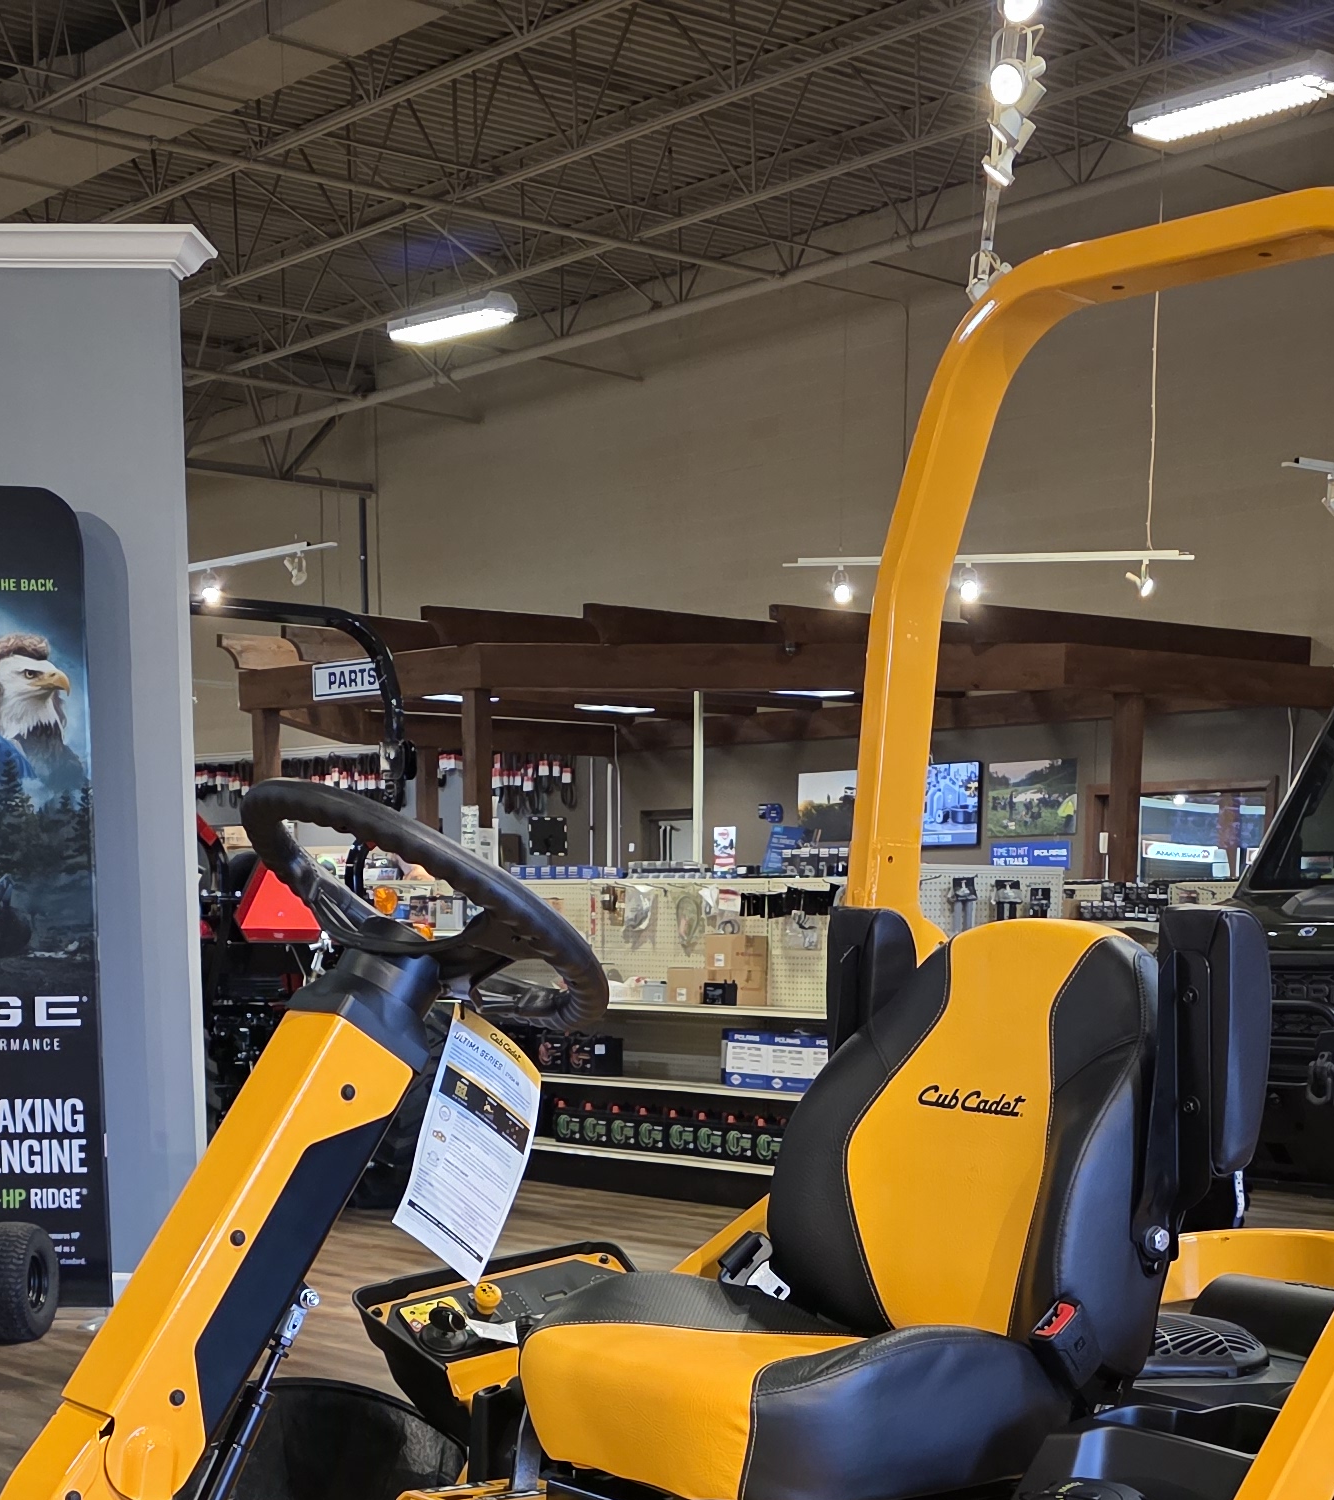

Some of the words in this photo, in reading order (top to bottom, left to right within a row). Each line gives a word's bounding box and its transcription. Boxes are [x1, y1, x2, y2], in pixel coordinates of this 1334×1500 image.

[21, 579, 58, 592] BACK.
[328, 667, 377, 690] PARTS
[993, 857, 1005, 866] THE
[1006, 857, 1028, 866] TRAILS
[1008, 846, 1016, 856] TO
[1018, 846, 1028, 856] HIT
[454, 1031, 480, 1053] ULTIMA
[480, 1050, 503, 1070] SERIES
[918, 1085, 960, 1109] Cub
[961, 1091, 1026, 1117] Cadet
[30, 1188, 81, 1209] RIDGE
